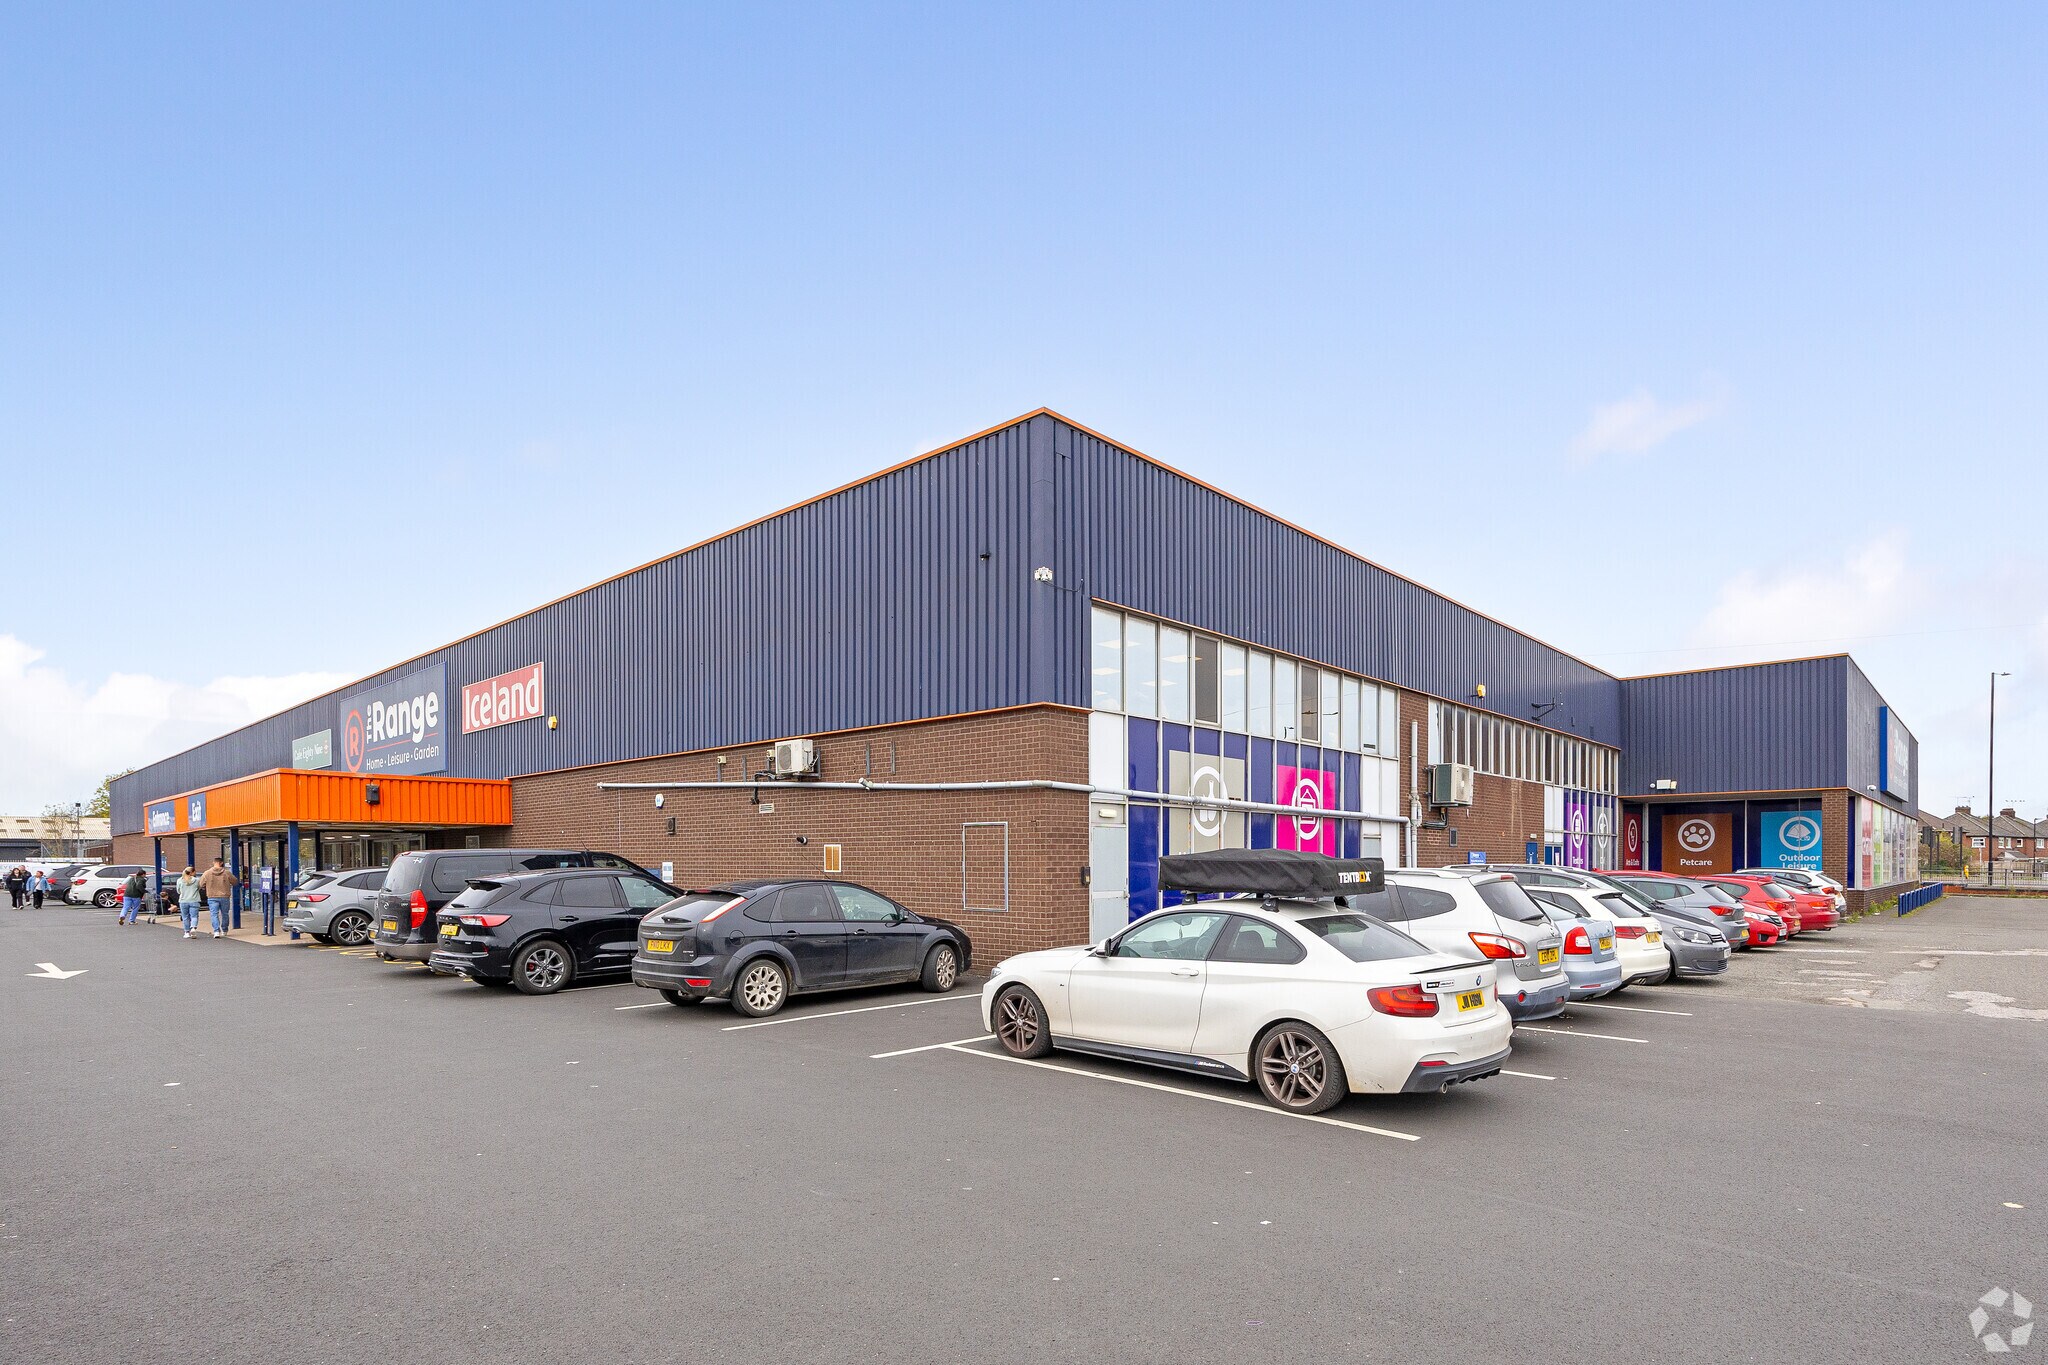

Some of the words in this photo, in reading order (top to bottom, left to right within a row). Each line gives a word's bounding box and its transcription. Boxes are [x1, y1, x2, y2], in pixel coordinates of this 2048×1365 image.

[465, 667, 540, 730] Iceland
[373, 691, 439, 744] Range
[366, 756, 384, 771] Home
[387, 751, 410, 767] Leisure
[413, 743, 440, 760] Garden
[1679, 858, 1713, 866] Petcare
[1778, 853, 1821, 862] Outdoor
[1782, 862, 1817, 870] Leisure
